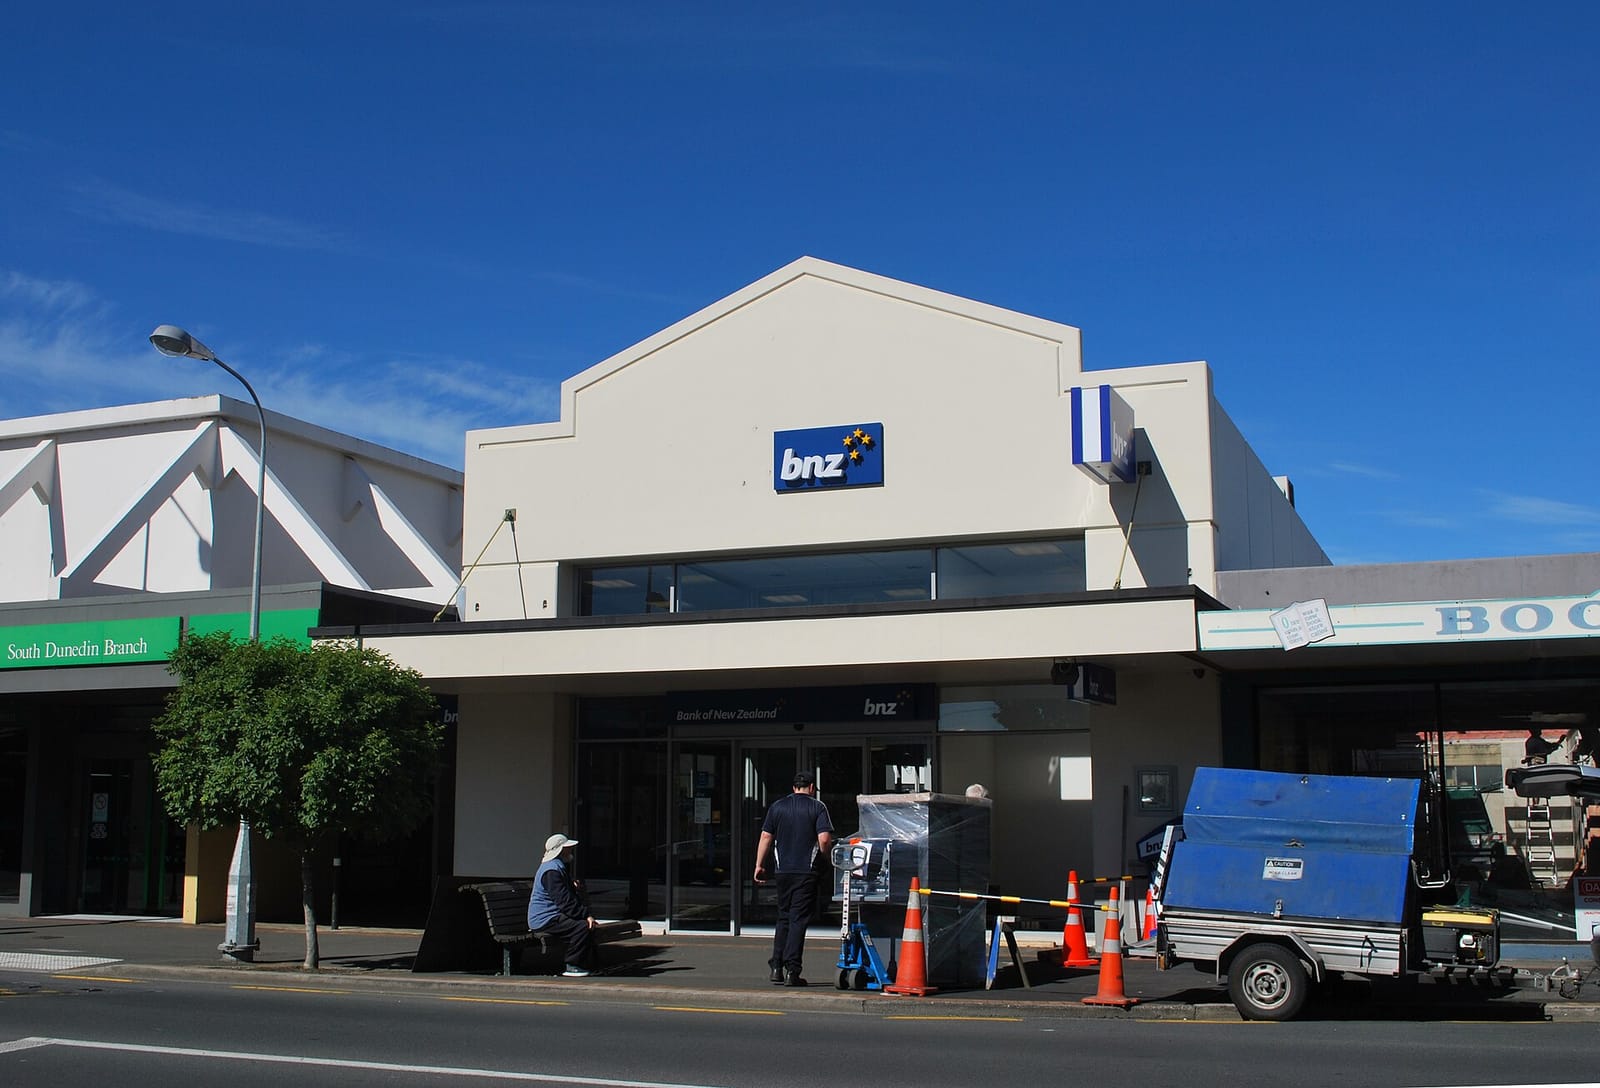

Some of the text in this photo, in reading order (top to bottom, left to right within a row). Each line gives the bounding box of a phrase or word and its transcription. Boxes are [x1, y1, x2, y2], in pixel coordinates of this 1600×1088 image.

[1113, 420, 1129, 465] bnz
[780, 448, 844, 480] bnz
[7, 637, 148, 660] South Dunedin Branch
[676, 707, 777, 721] Bank of New Zealand
[863, 698, 897, 715] bnz
